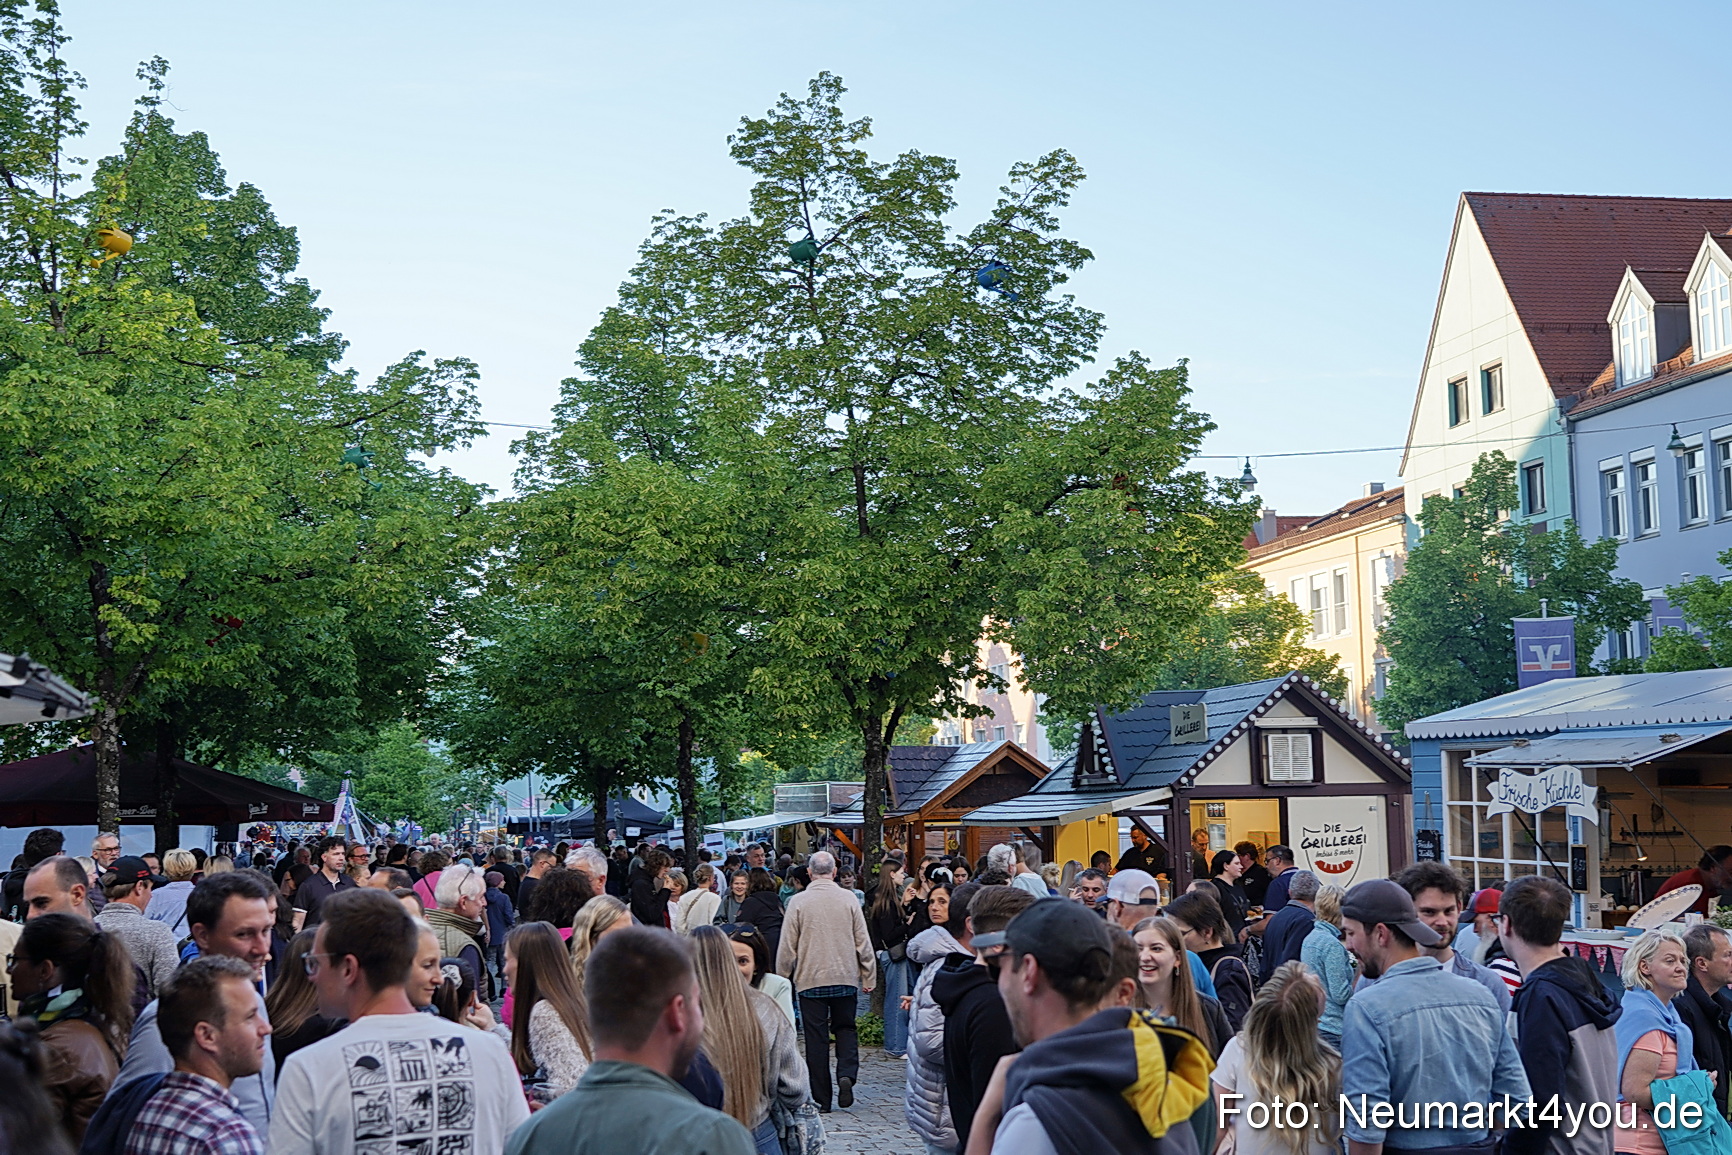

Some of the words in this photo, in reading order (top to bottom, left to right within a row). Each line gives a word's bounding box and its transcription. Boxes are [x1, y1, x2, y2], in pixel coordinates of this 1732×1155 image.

[1499, 771, 1539, 810] Frische
[1539, 770, 1581, 806] Küchle
[1324, 823, 1341, 833] DIE
[1300, 834, 1367, 849] GRILLEREI
